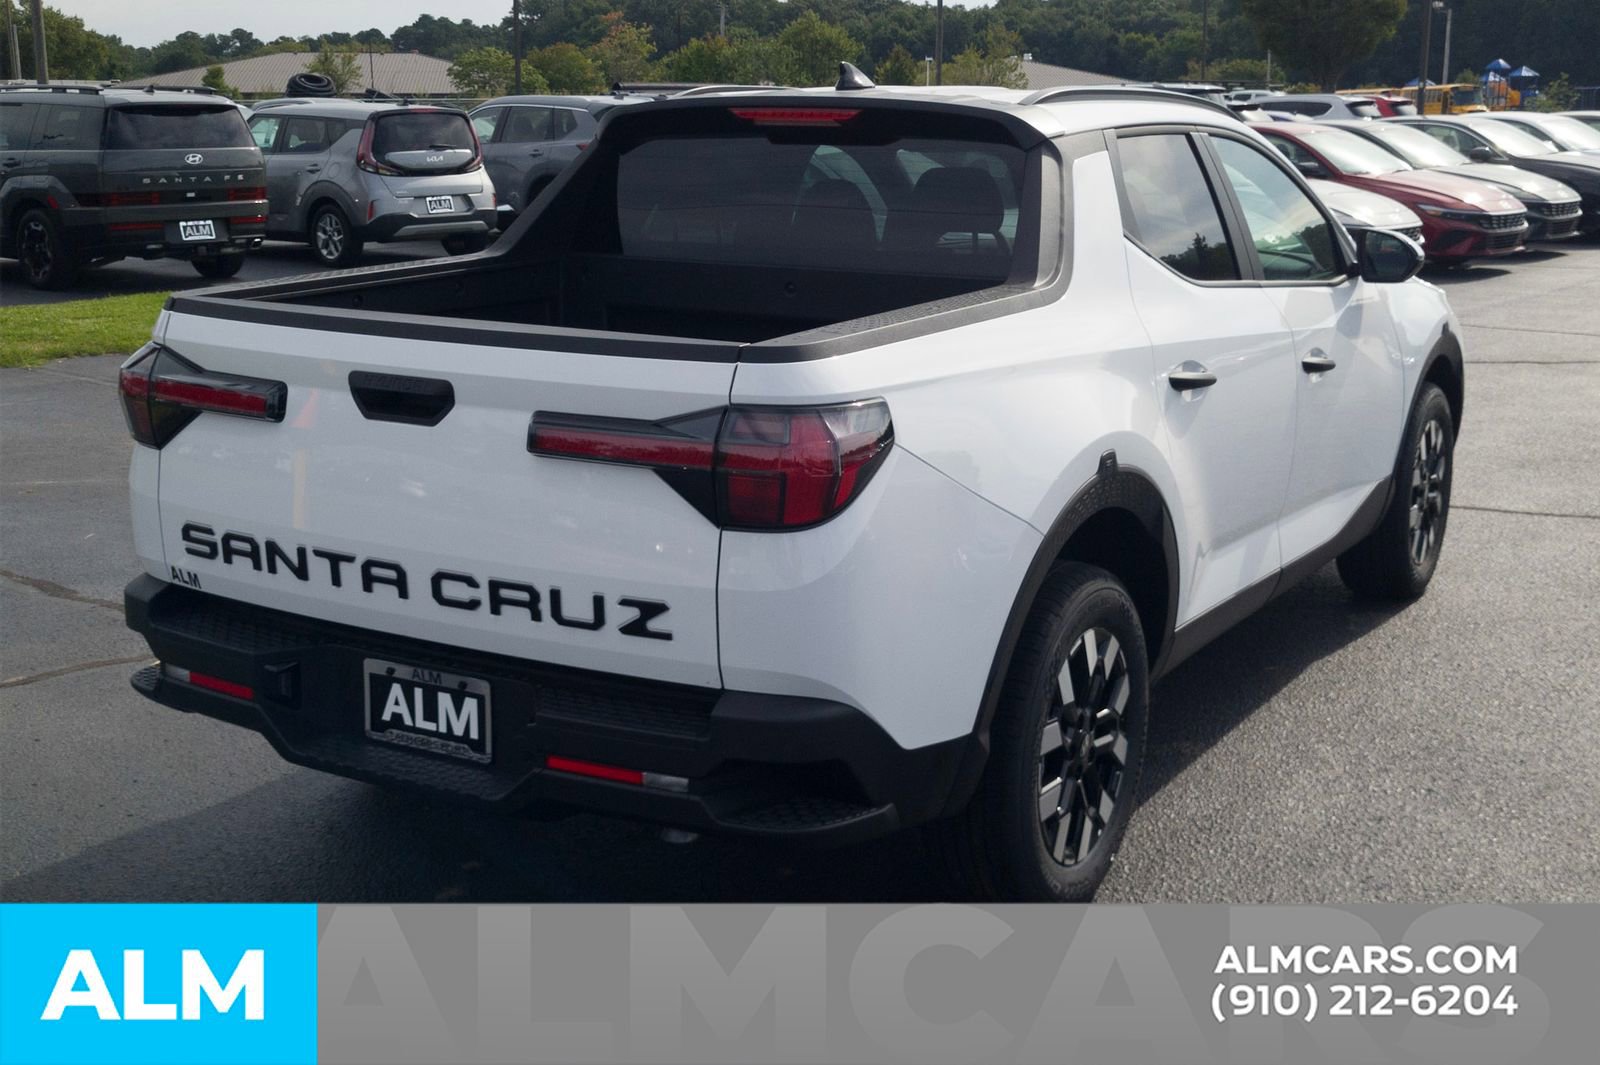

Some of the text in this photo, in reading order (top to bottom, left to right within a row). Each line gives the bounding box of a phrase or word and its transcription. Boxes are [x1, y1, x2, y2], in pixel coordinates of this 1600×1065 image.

[142, 176, 212, 184] SANTA
[431, 199, 451, 210] ALM
[185, 225, 211, 237] ALM
[171, 565, 202, 589] ALM
[181, 521, 673, 641] SANTA CRUZ
[411, 667, 443, 685] ALM
[381, 682, 480, 740] ALM
